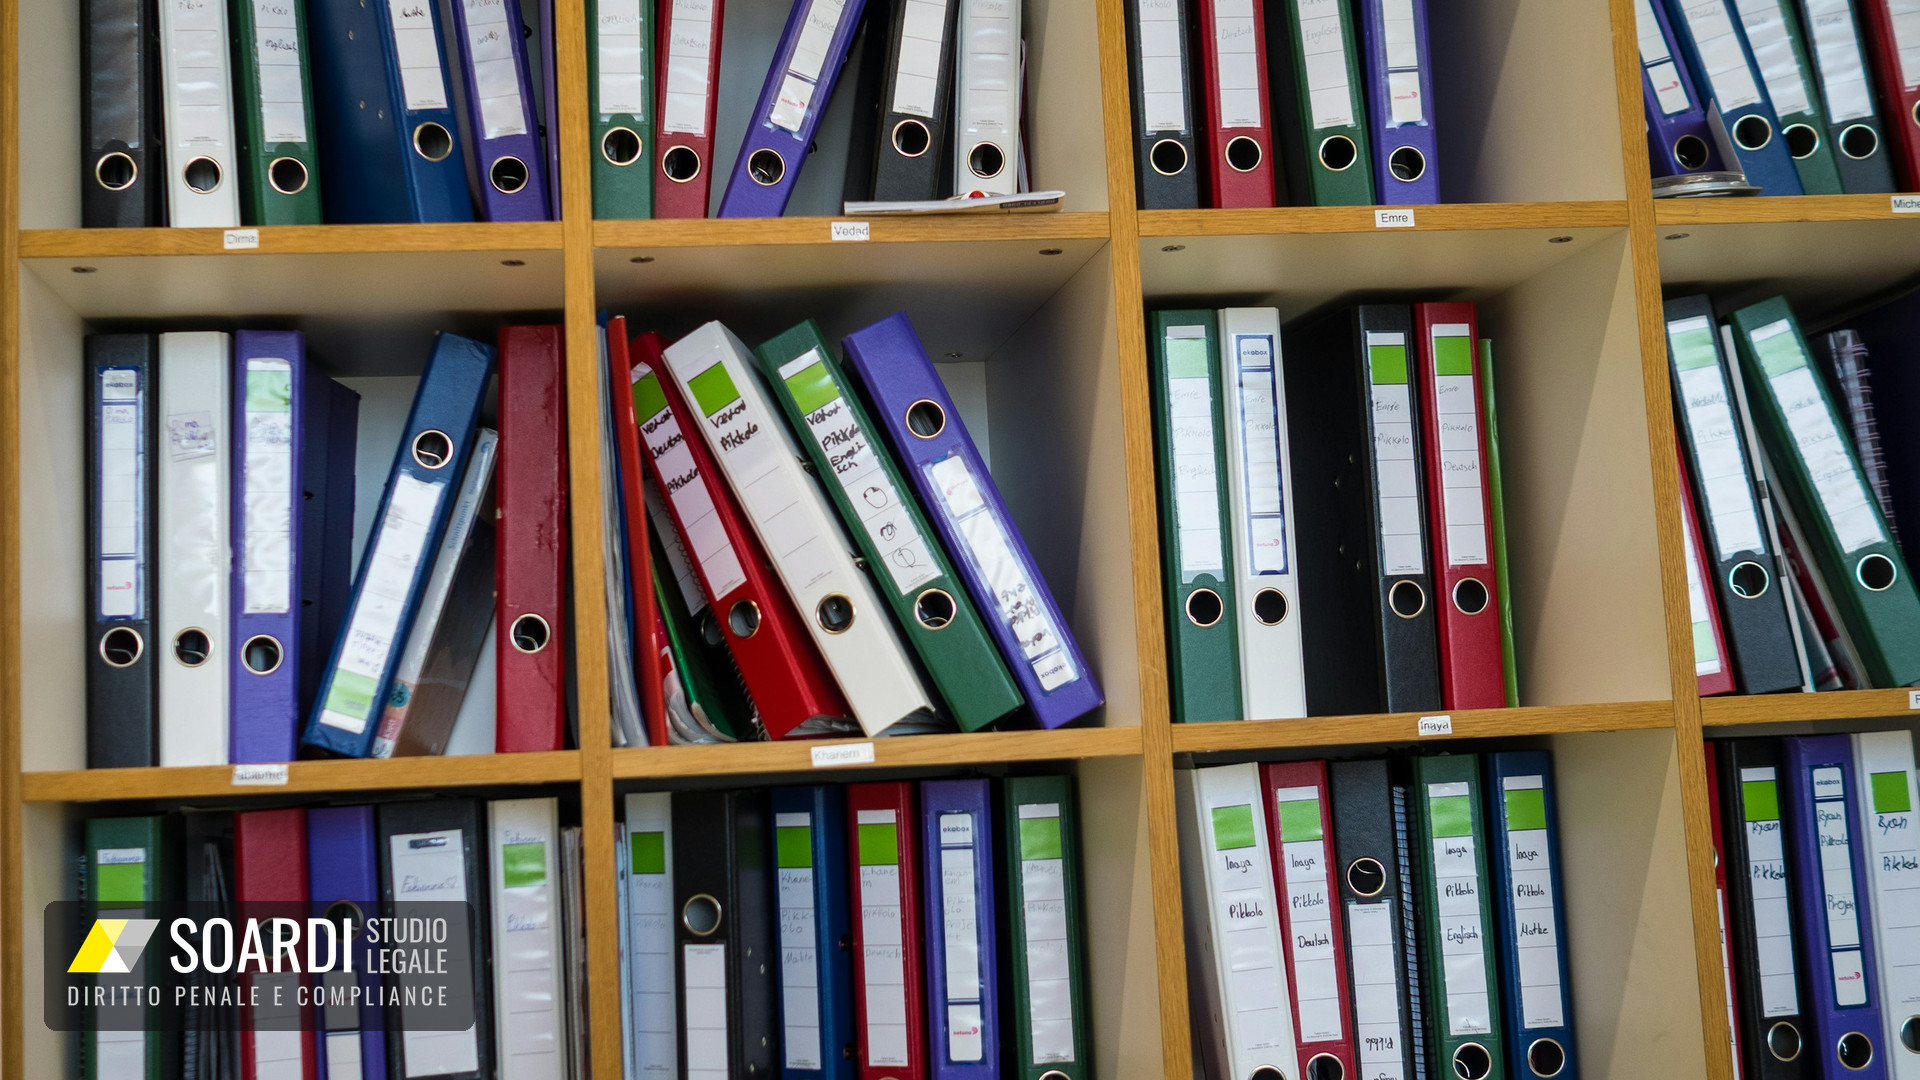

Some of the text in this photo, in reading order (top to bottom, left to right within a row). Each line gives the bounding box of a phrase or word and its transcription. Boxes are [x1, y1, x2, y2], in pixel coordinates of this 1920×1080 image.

[1381, 213, 1409, 224] Emre
[1515, 843, 1539, 860] Inaya
[1226, 855, 1253, 874] Inaya
[1291, 853, 1316, 871] Inaya
[1445, 884, 1475, 898] Pikkolo
[1517, 884, 1545, 897] Pikkolo
[1292, 893, 1324, 909] Pikkolo
[1229, 904, 1263, 919] Pikkolo
[1447, 925, 1479, 944] Englisch
